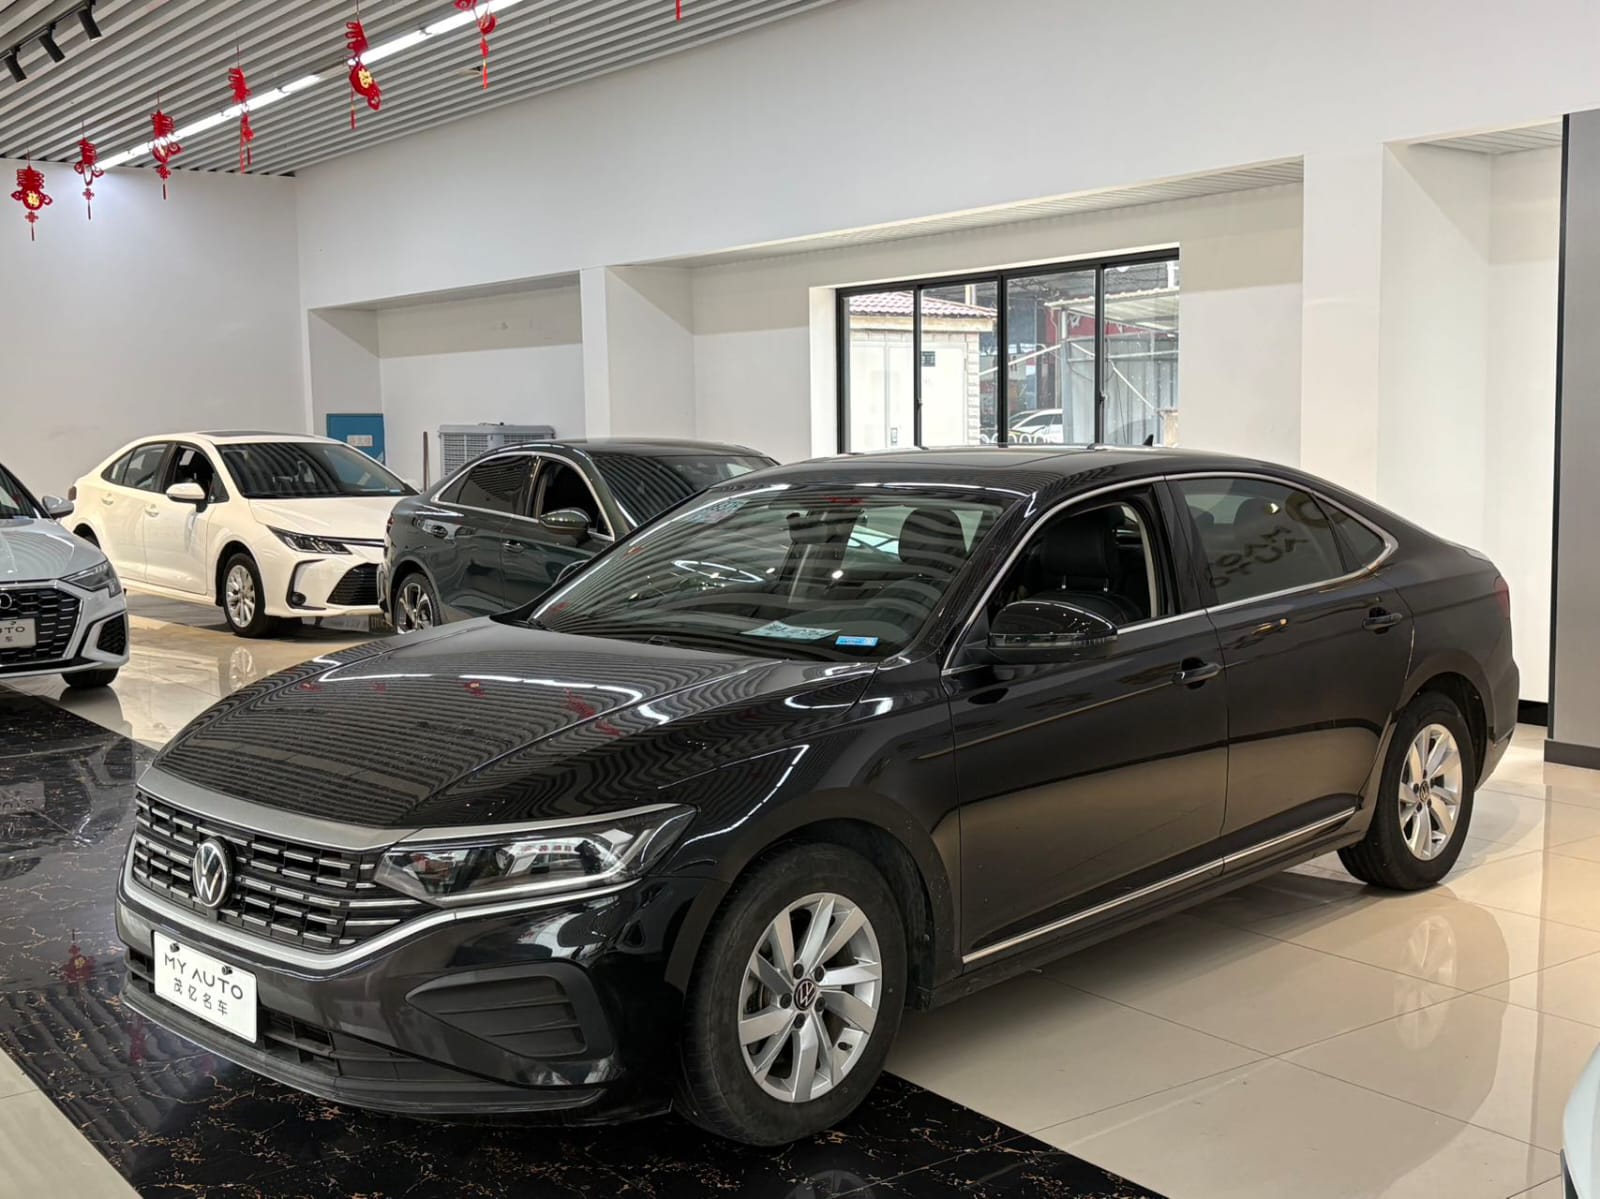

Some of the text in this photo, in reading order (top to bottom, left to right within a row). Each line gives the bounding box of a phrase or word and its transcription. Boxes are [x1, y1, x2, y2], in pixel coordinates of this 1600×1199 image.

[0, 625, 25, 634] TO
[164, 952, 244, 1000] MY AUTO
[173, 977, 228, 1016] 茂亿名车
